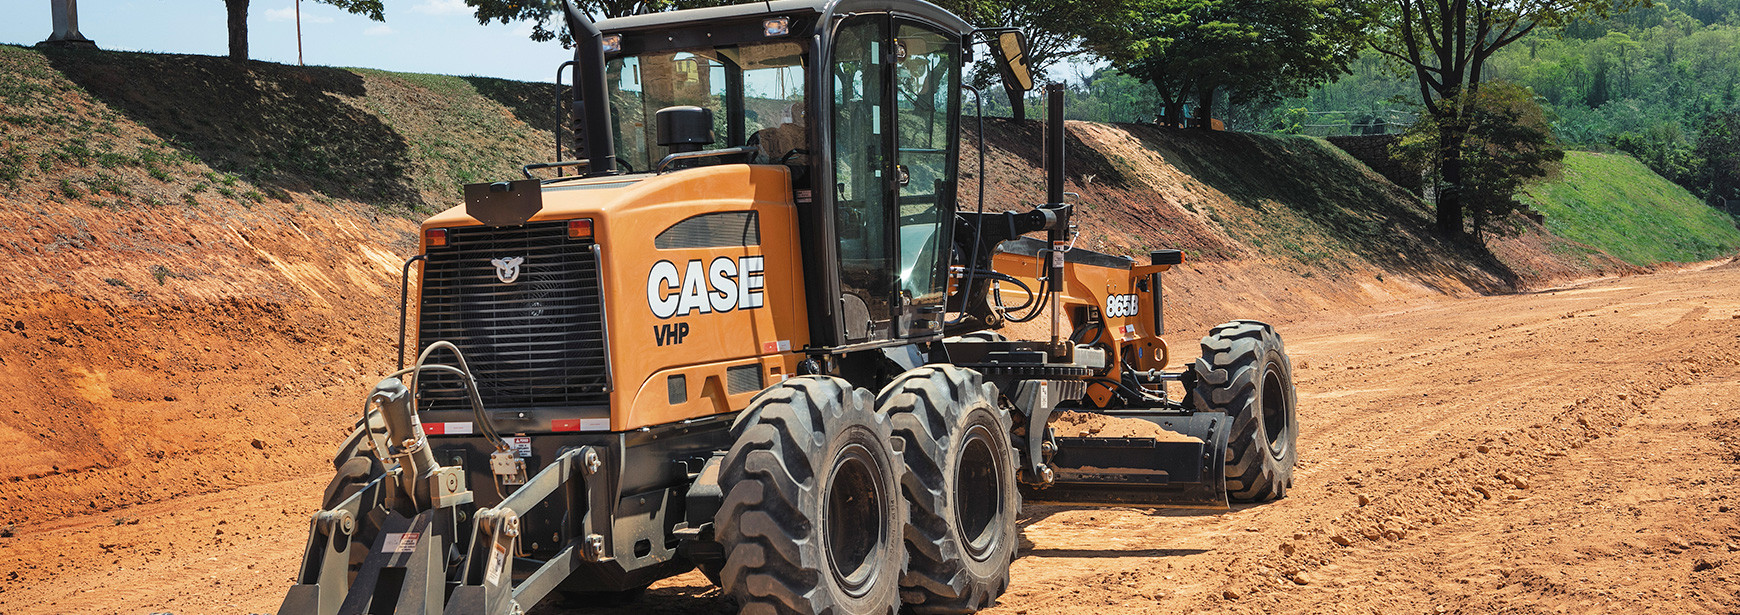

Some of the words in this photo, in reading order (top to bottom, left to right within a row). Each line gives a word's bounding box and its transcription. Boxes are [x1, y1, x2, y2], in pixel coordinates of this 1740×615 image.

[647, 255, 764, 319] CASE
[1106, 294, 1139, 318] 865B
[653, 322, 689, 346] VHP
